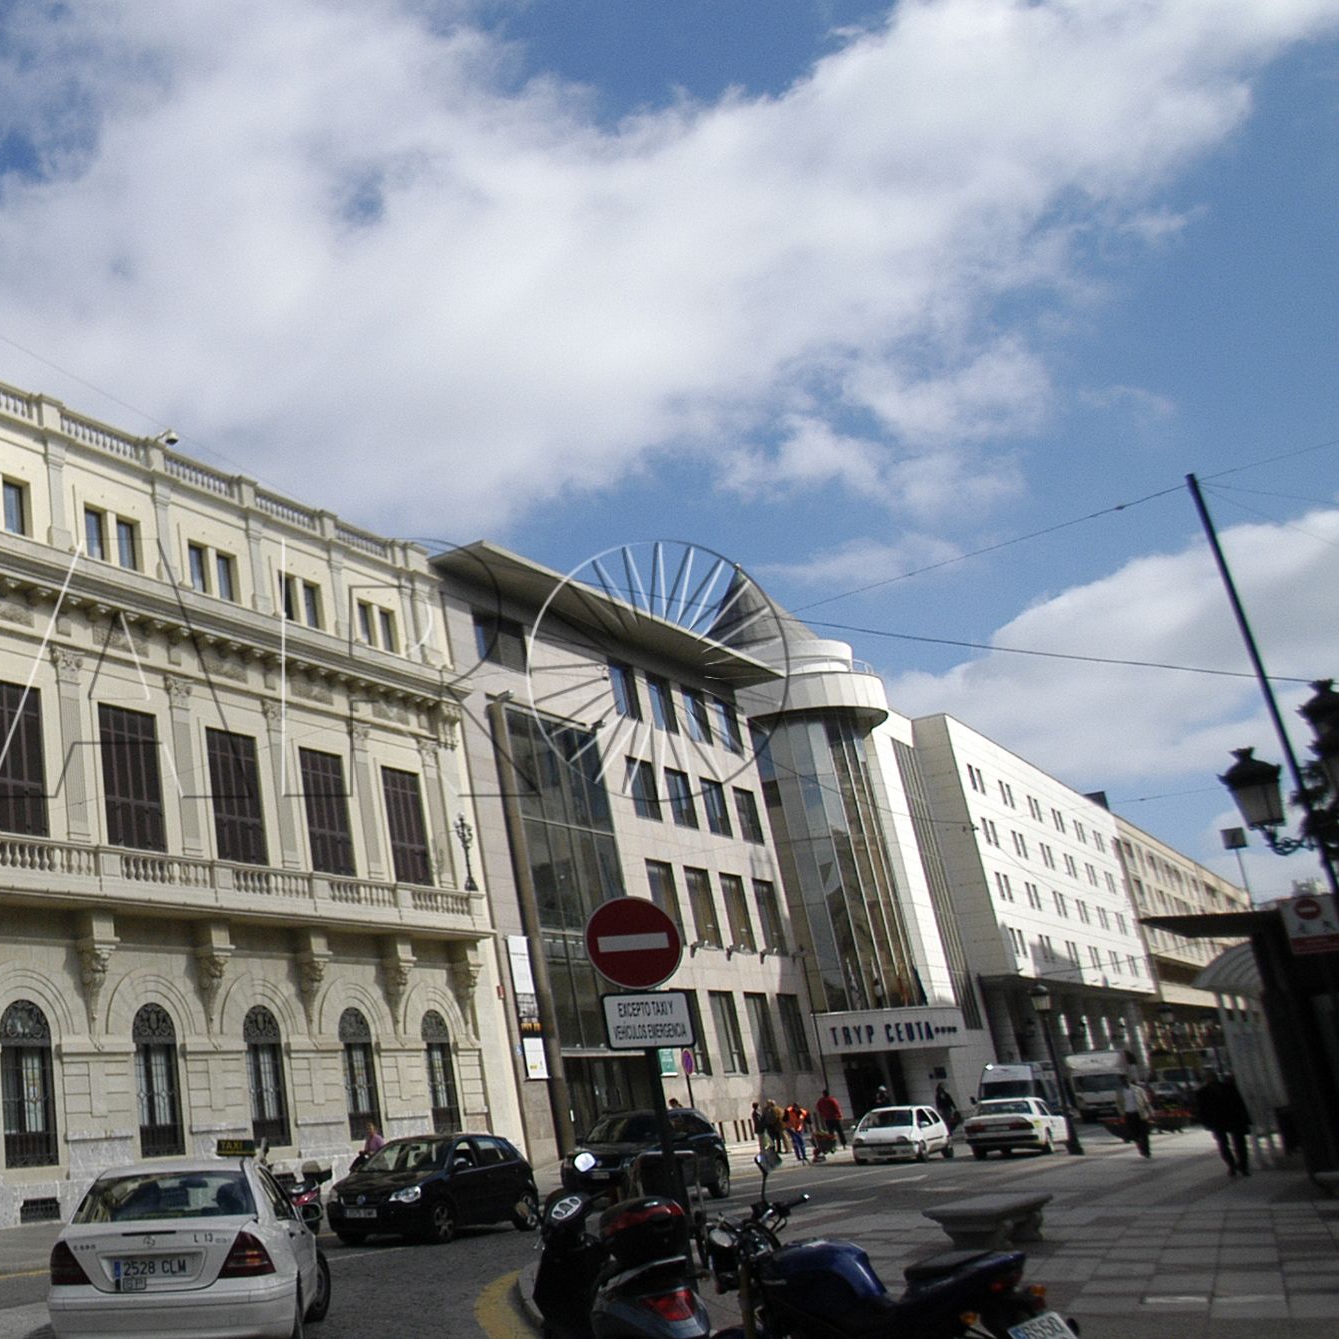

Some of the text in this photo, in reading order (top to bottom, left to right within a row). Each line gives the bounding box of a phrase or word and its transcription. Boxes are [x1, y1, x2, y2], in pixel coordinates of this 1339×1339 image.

[617, 1000, 674, 1018] EXCEPTO TAXI Y
[647, 1022, 688, 1039] EMERGENCIA
[829, 1021, 935, 1046] TRYP CEUTA
[220, 1140, 243, 1150] TAXI
[123, 1259, 187, 1277] 2528 CLM
